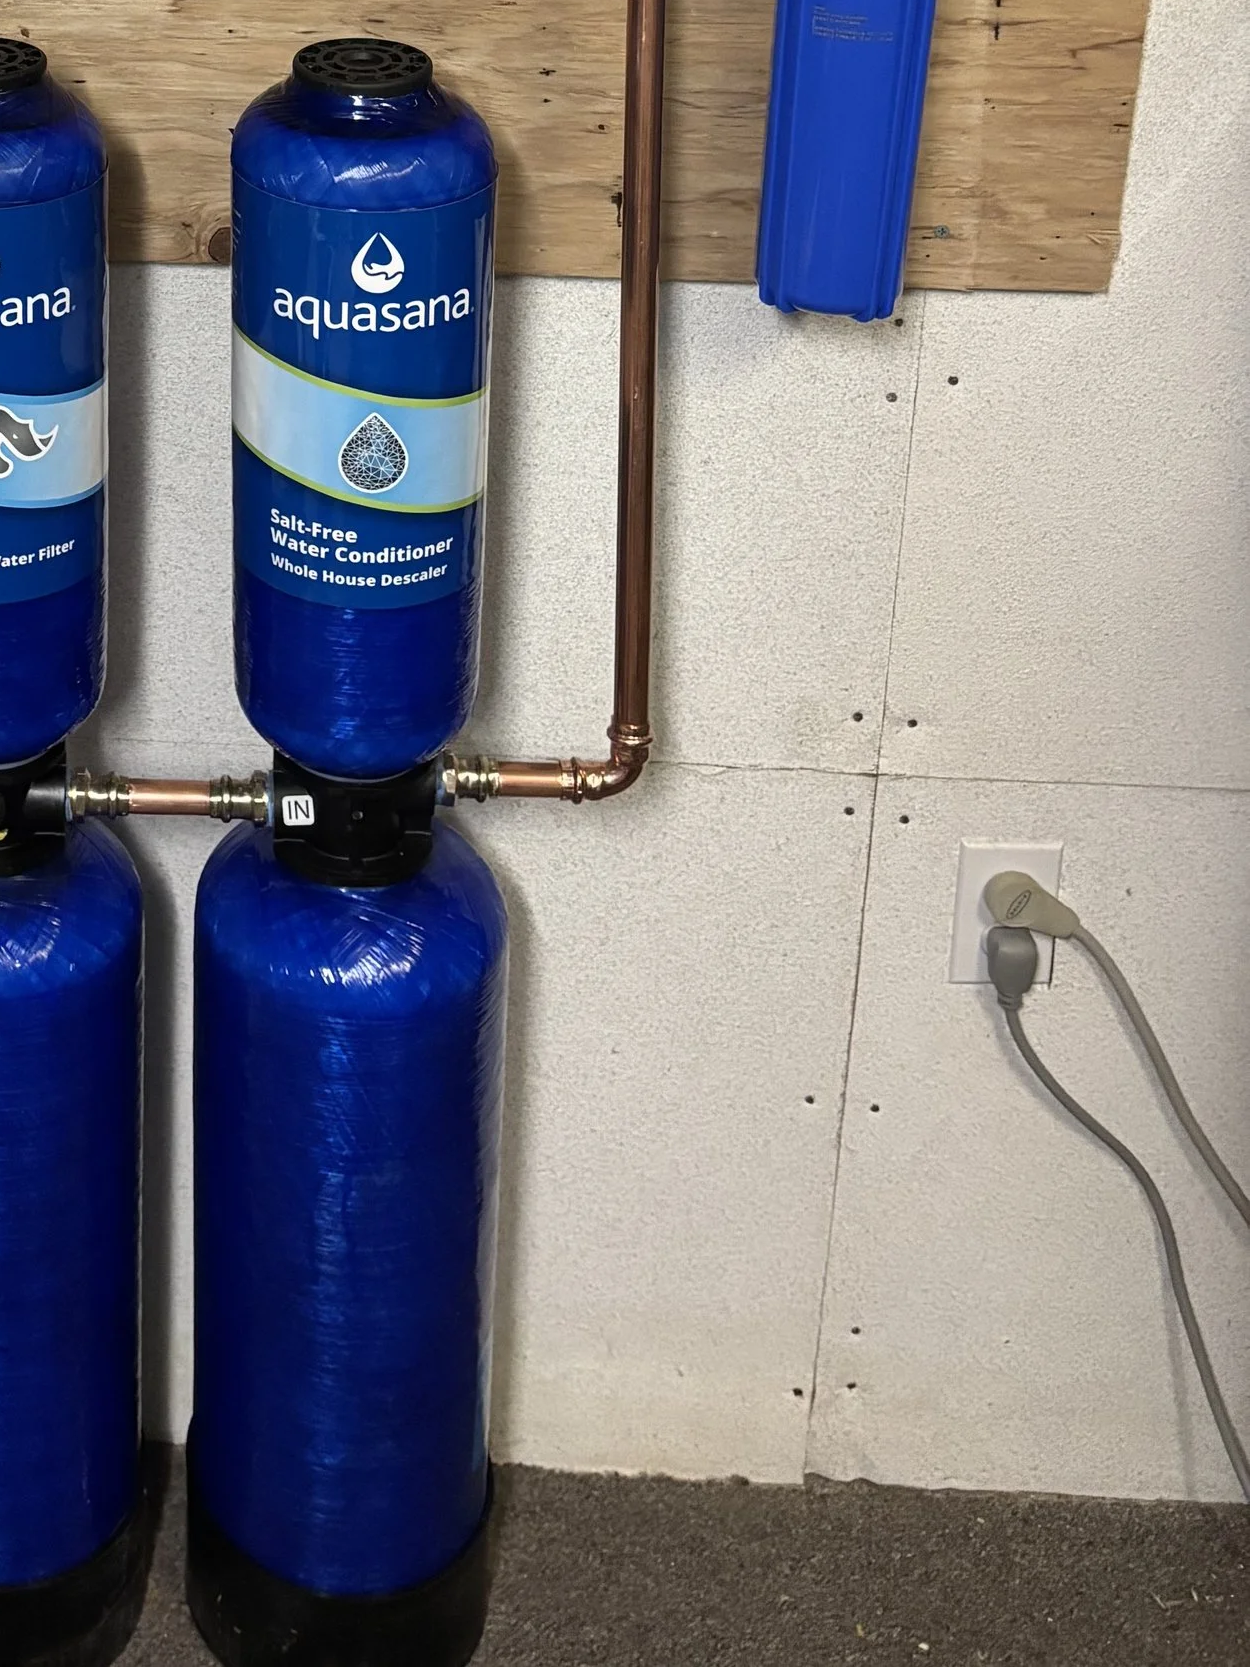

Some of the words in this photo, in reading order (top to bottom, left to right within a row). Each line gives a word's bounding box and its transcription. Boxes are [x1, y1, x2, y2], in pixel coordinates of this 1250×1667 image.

[273, 288, 470, 340] aquasana
[270, 508, 358, 544] Salt-Free
[38, 539, 75, 562] Filter
[270, 526, 329, 559] Water
[334, 537, 454, 564] Conditioner
[270, 552, 318, 580] Whole
[322, 569, 376, 587] House
[381, 564, 448, 586] Descaler
[287, 799, 310, 820] IN
